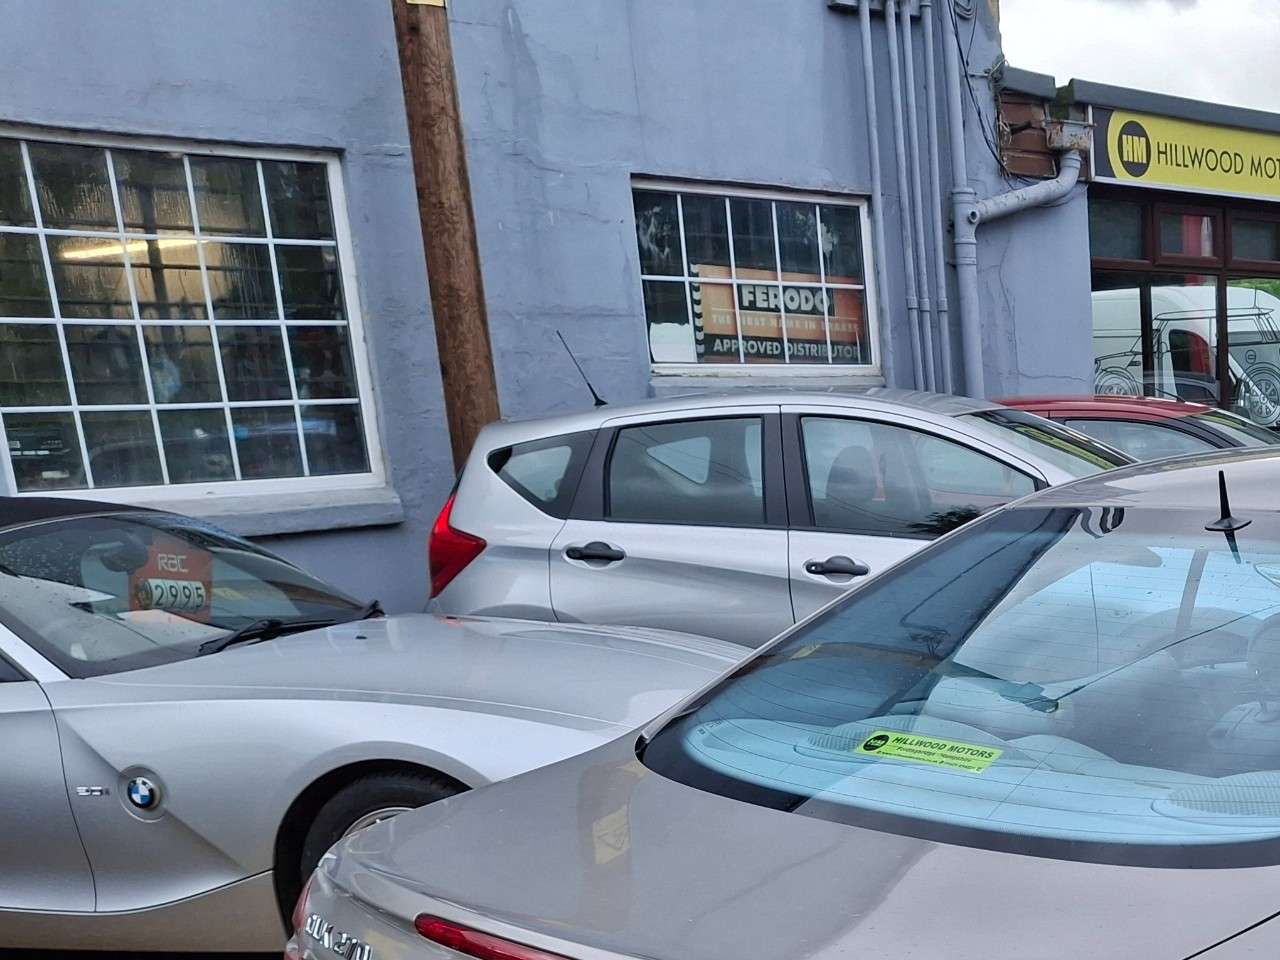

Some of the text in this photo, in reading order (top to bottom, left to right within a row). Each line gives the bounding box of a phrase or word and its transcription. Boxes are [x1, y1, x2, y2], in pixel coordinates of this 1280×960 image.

[1122, 134, 1147, 164] HM
[1156, 141, 1244, 174] HILLWOOD
[740, 284, 830, 312] FERODO
[713, 338, 781, 355] APPROVED
[153, 584, 205, 609] 2995
[892, 736, 947, 751] HILLWOOD
[947, 745, 995, 759] MOTORS
